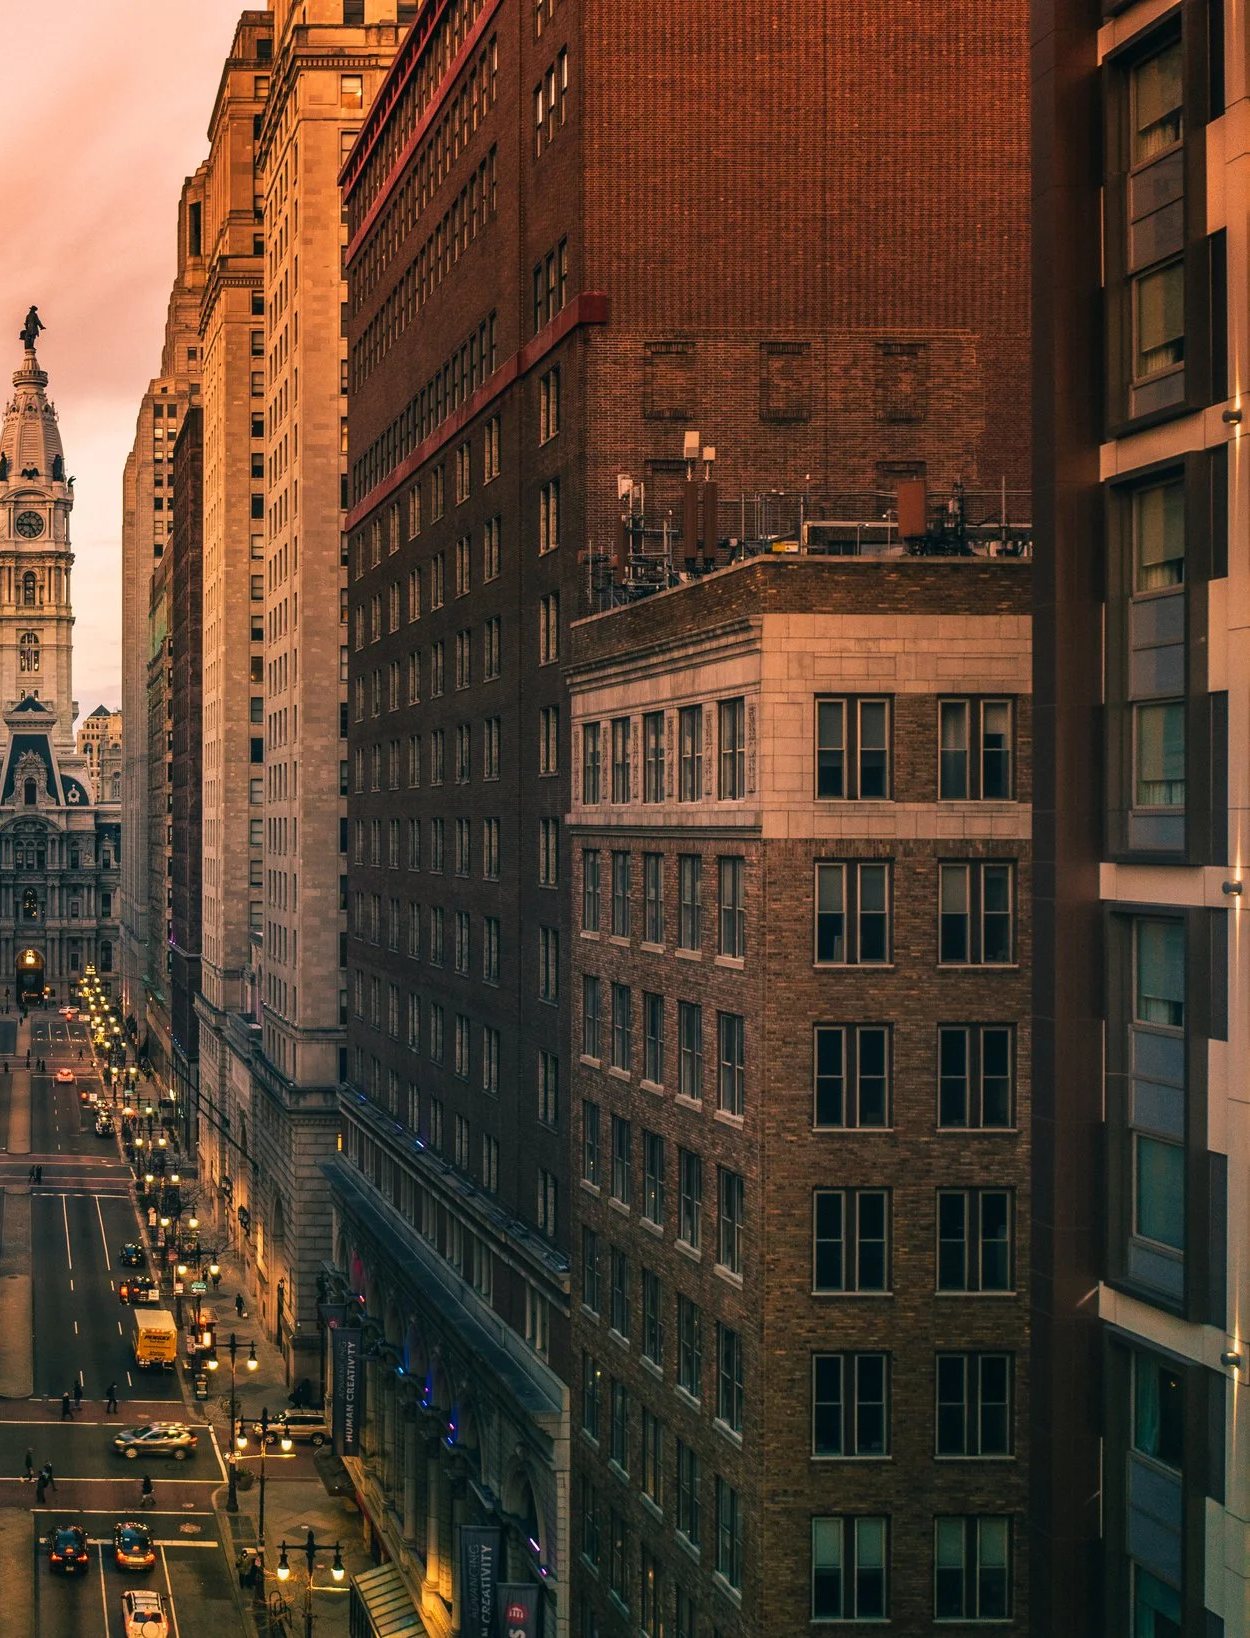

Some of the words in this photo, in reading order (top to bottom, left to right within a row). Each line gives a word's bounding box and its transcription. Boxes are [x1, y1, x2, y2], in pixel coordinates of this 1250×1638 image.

[345, 1404, 354, 1443] HUMAN
[469, 1544, 479, 1619] ADVANCING
[480, 1544, 492, 1624] CREATIVITY
